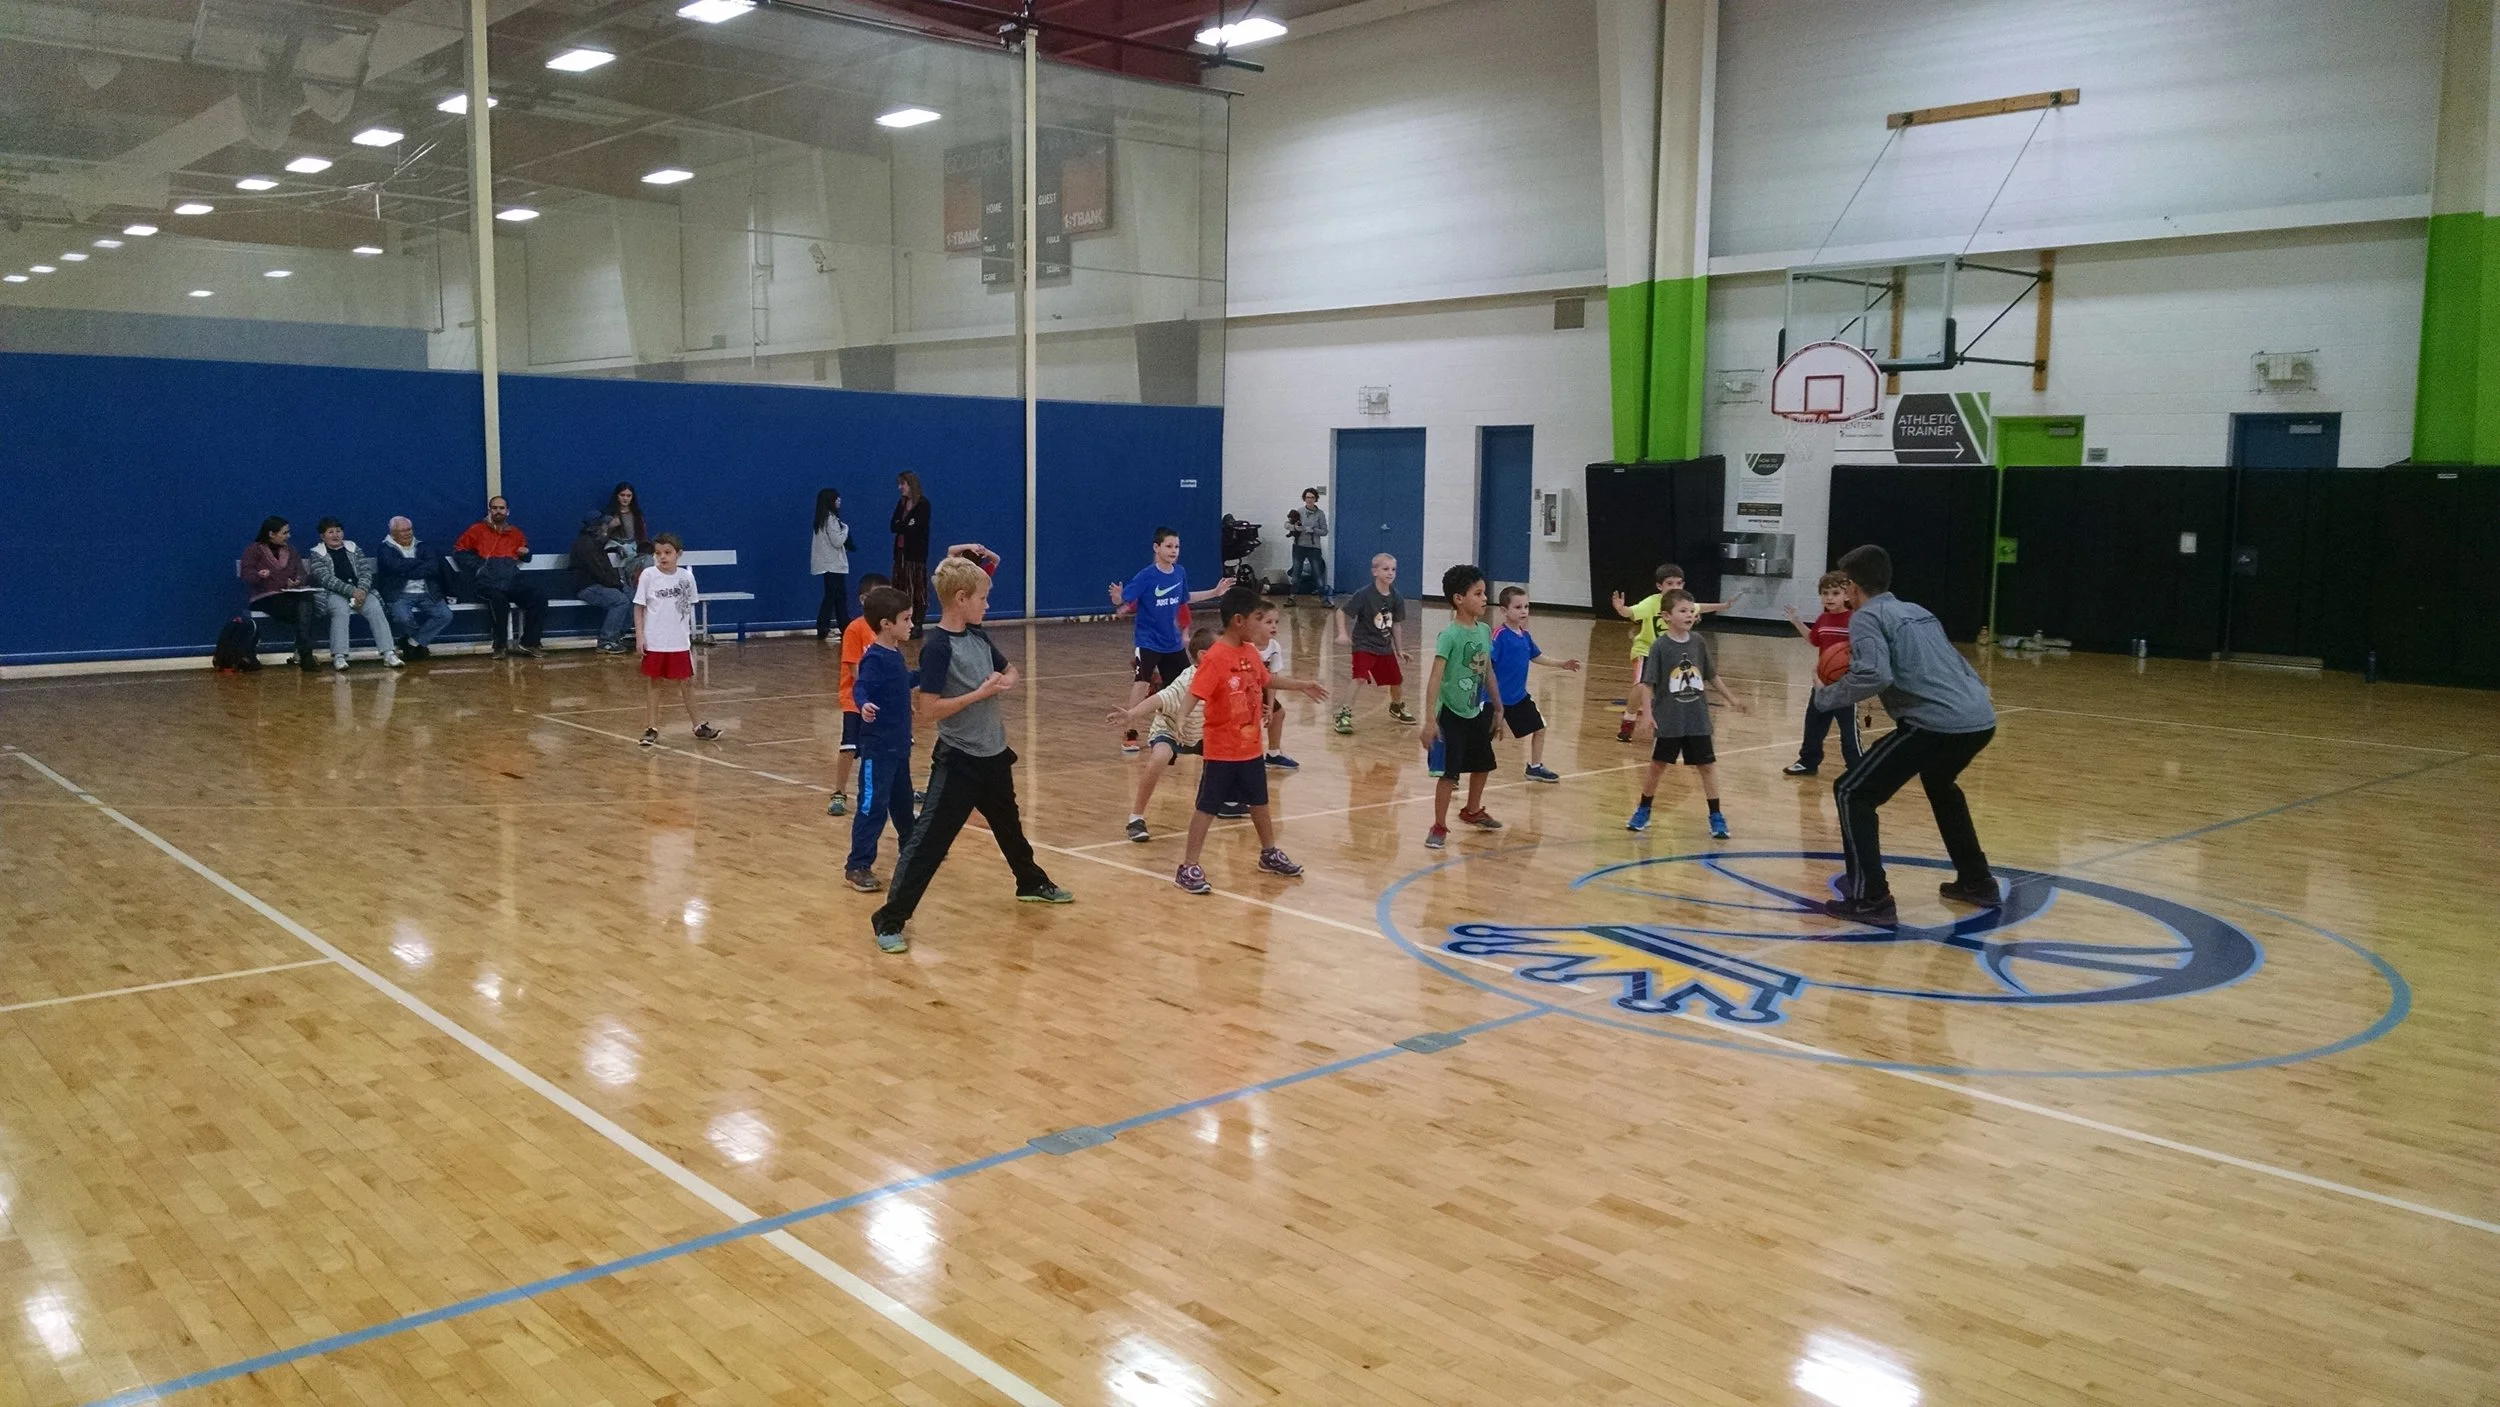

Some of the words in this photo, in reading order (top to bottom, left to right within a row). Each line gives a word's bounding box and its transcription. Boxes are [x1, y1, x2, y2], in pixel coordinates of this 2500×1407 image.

[986, 202, 1002, 214] HOME
[1898, 413, 1958, 425] ATHLETIC
[1840, 421, 1873, 430] CENTER
[1900, 425, 1955, 437] TRAINER
